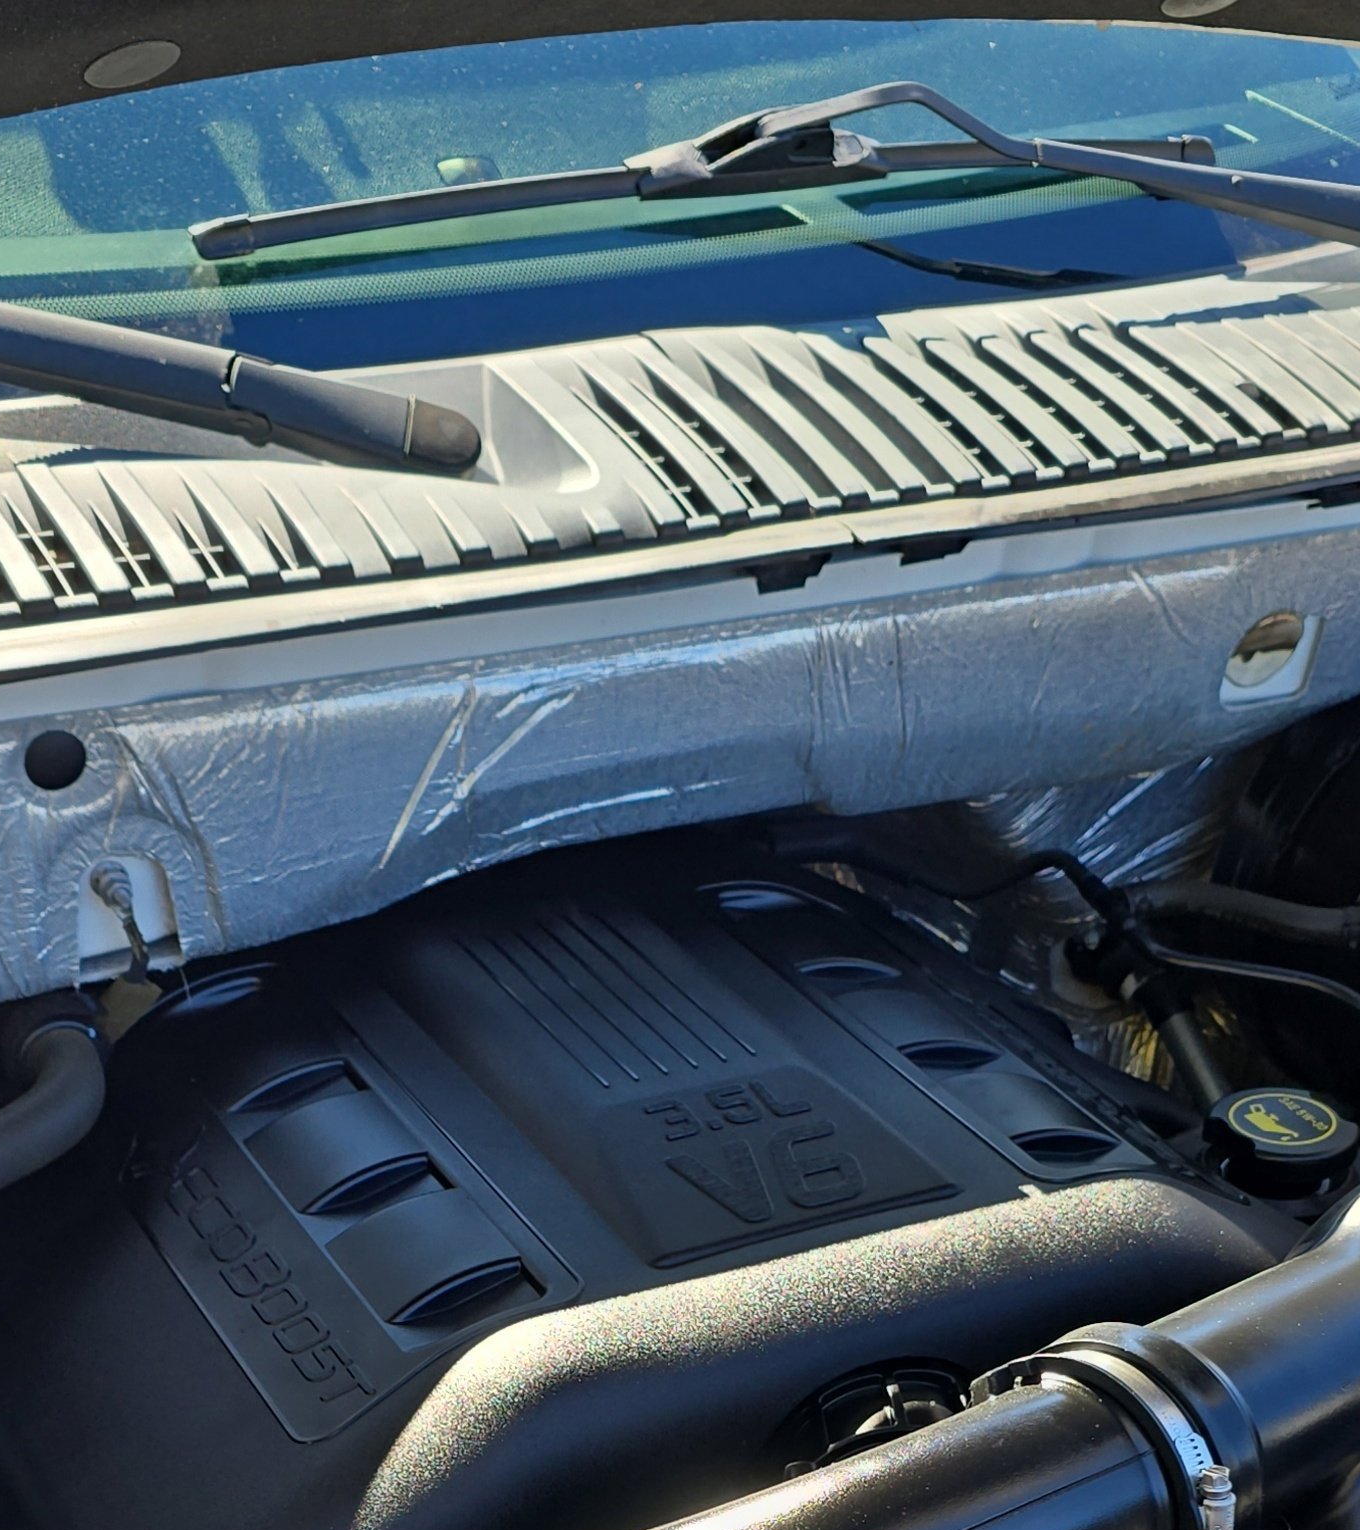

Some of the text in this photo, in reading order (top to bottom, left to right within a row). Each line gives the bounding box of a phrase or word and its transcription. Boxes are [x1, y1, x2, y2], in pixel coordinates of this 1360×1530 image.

[643, 1078, 812, 1142] 3.5L
[664, 1118, 866, 1224] V6
[165, 1164, 376, 1405] ECOBOOST
